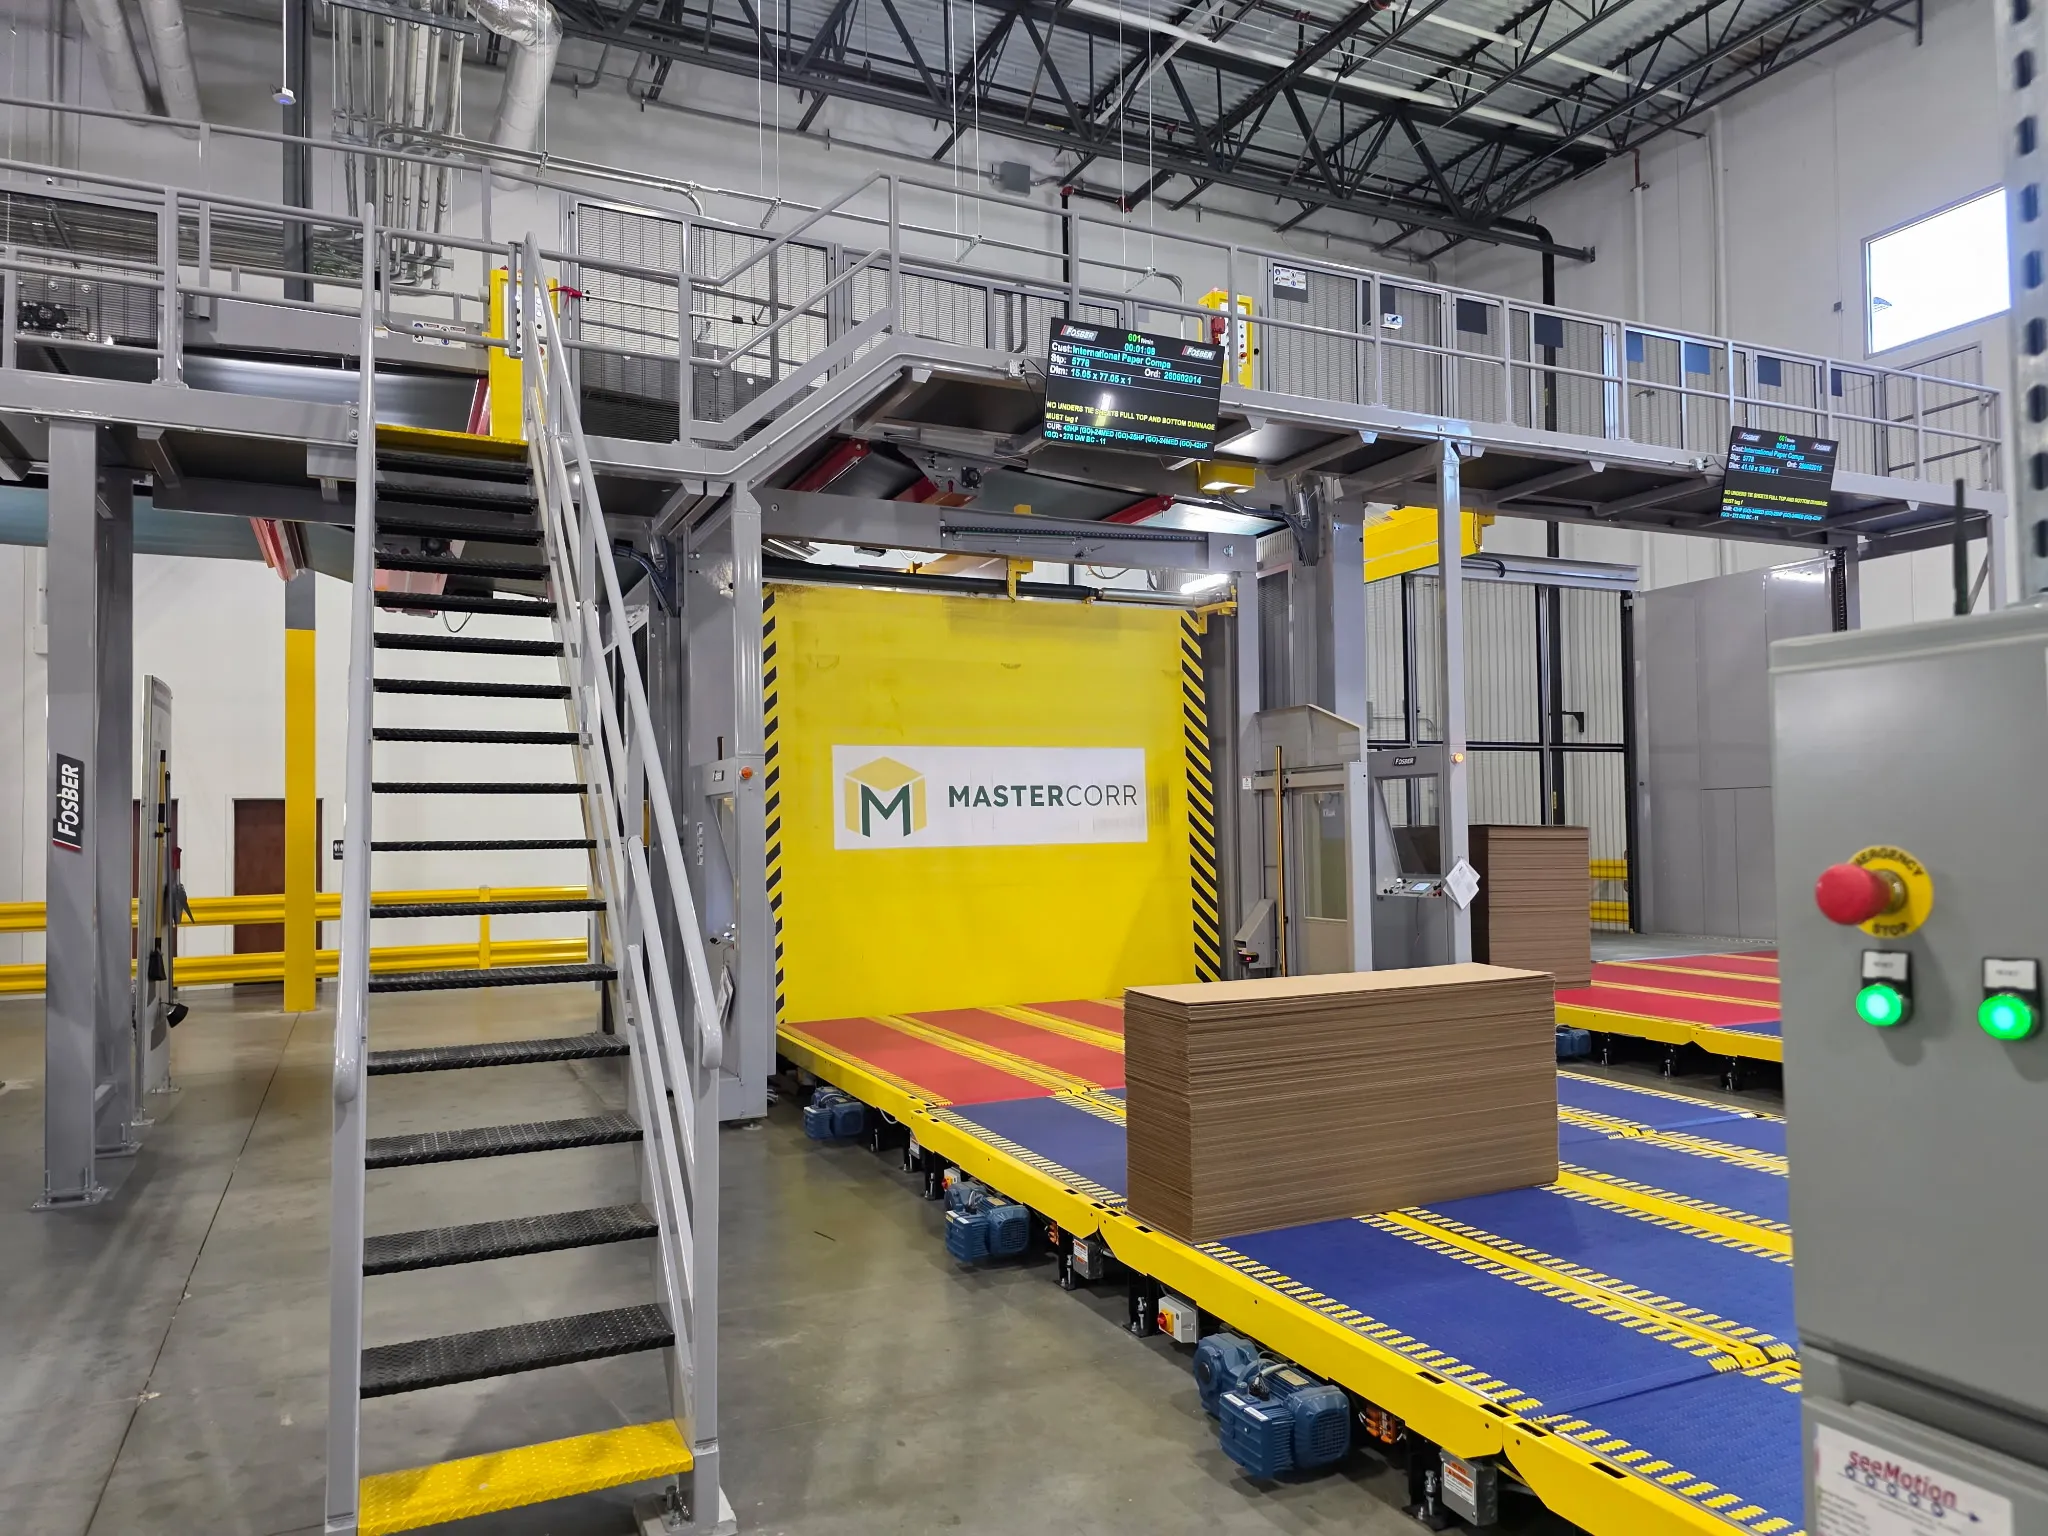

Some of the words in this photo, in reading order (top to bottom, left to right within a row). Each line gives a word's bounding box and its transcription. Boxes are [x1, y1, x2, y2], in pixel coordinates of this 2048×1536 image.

[1066, 326, 1095, 341] FOSBER
[1128, 333, 1141, 343] 601
[1051, 341, 1072, 353] Cust:
[1072, 345, 1120, 361] International
[1122, 353, 1143, 365] Paper
[1145, 358, 1171, 369] Compa
[1187, 346, 1213, 359] FOSBER
[1049, 365, 1068, 375] Dim:
[1144, 368, 1161, 379] Ord:
[1045, 412, 1063, 421] MUST
[1046, 400, 1056, 409] NO
[1057, 402, 1084, 413] UNDERS
[1084, 406, 1095, 414] TIE
[1119, 411, 1135, 419] FULL
[1136, 413, 1148, 422] TOP
[1148, 415, 1161, 424] AND
[1162, 417, 1187, 427] BOTTOM
[1187, 420, 1216, 431] DUNNAGE
[57, 763, 79, 837] FOSBER
[948, 784, 1138, 808] MASTERCORR
[1855, 847, 1924, 877] ERGENCY
[1872, 922, 1909, 937] STOP
[1849, 1451, 1958, 1509] seeMotion
